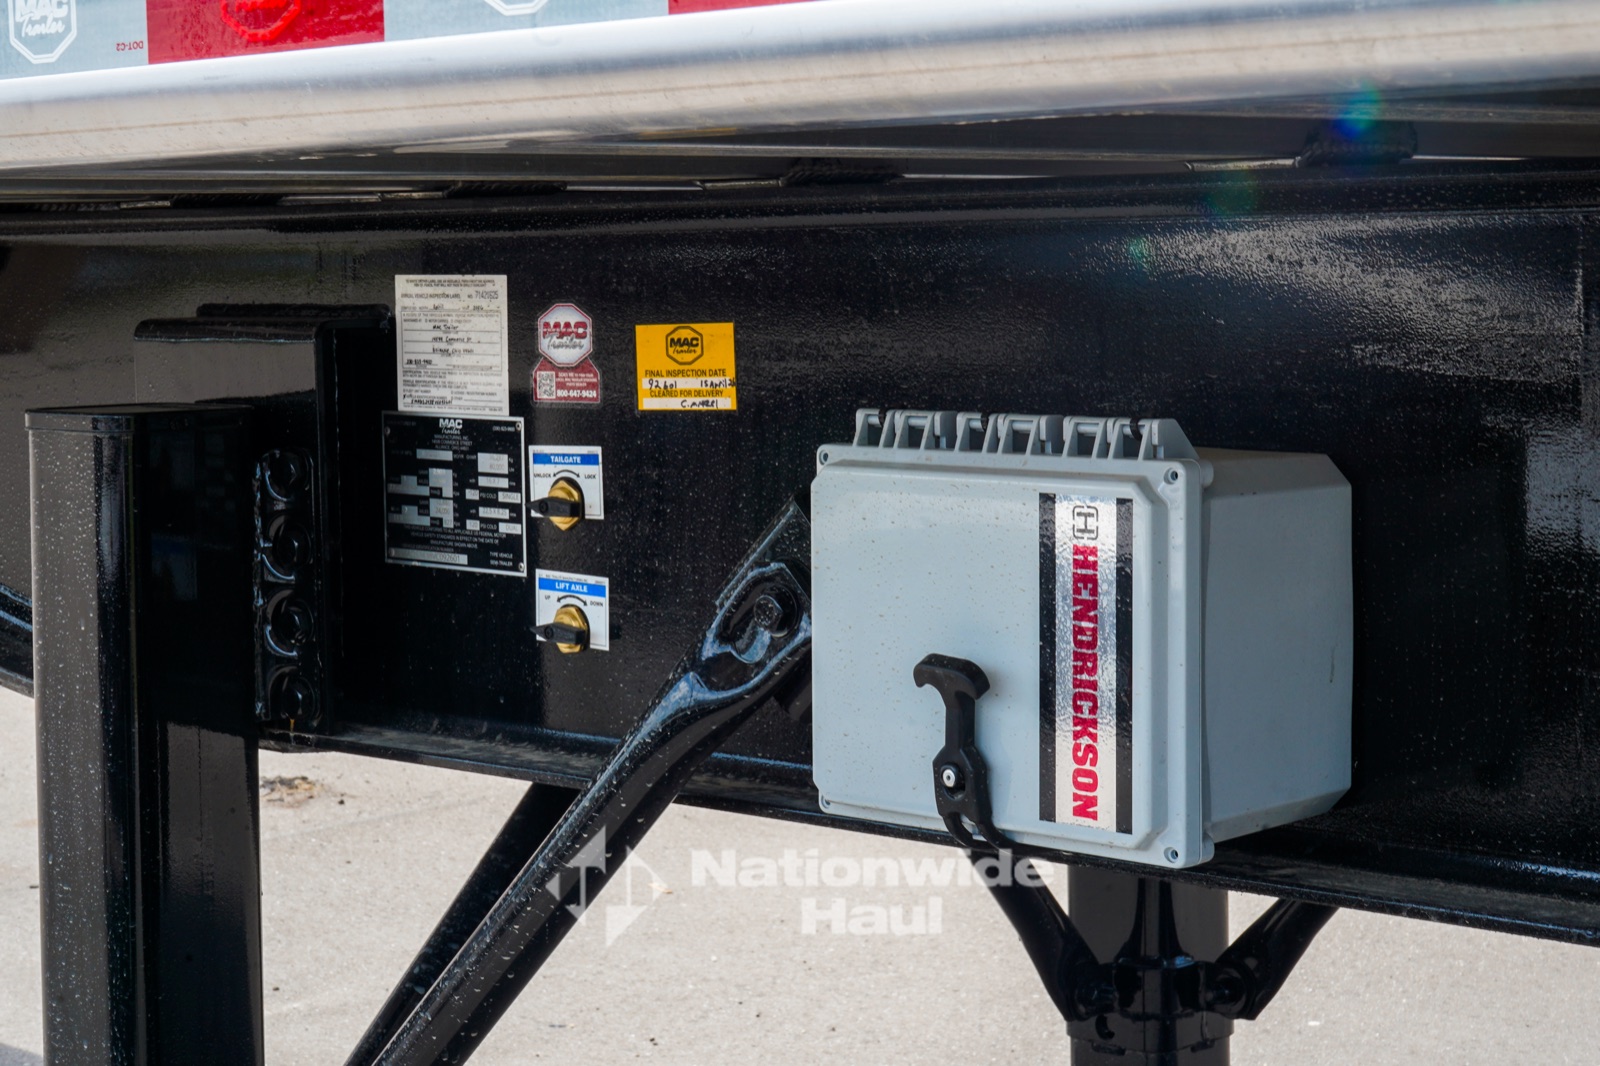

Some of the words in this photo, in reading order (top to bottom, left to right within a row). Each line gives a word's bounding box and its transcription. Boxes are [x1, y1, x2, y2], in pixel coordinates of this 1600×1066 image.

[15, 0, 68, 22] MAC
[116, 41, 144, 52] DOT-C2
[543, 322, 588, 339] MAC
[546, 332, 584, 350] Trailer
[670, 337, 699, 348] MAC
[666, 369, 707, 377] INSPECTION
[557, 389, 596, 398] 800-647-9424
[439, 418, 463, 429] MAC
[556, 582, 569, 590] LIFT
[571, 584, 588, 593] AXLE
[1072, 544, 1098, 820] HENDRICKSON
